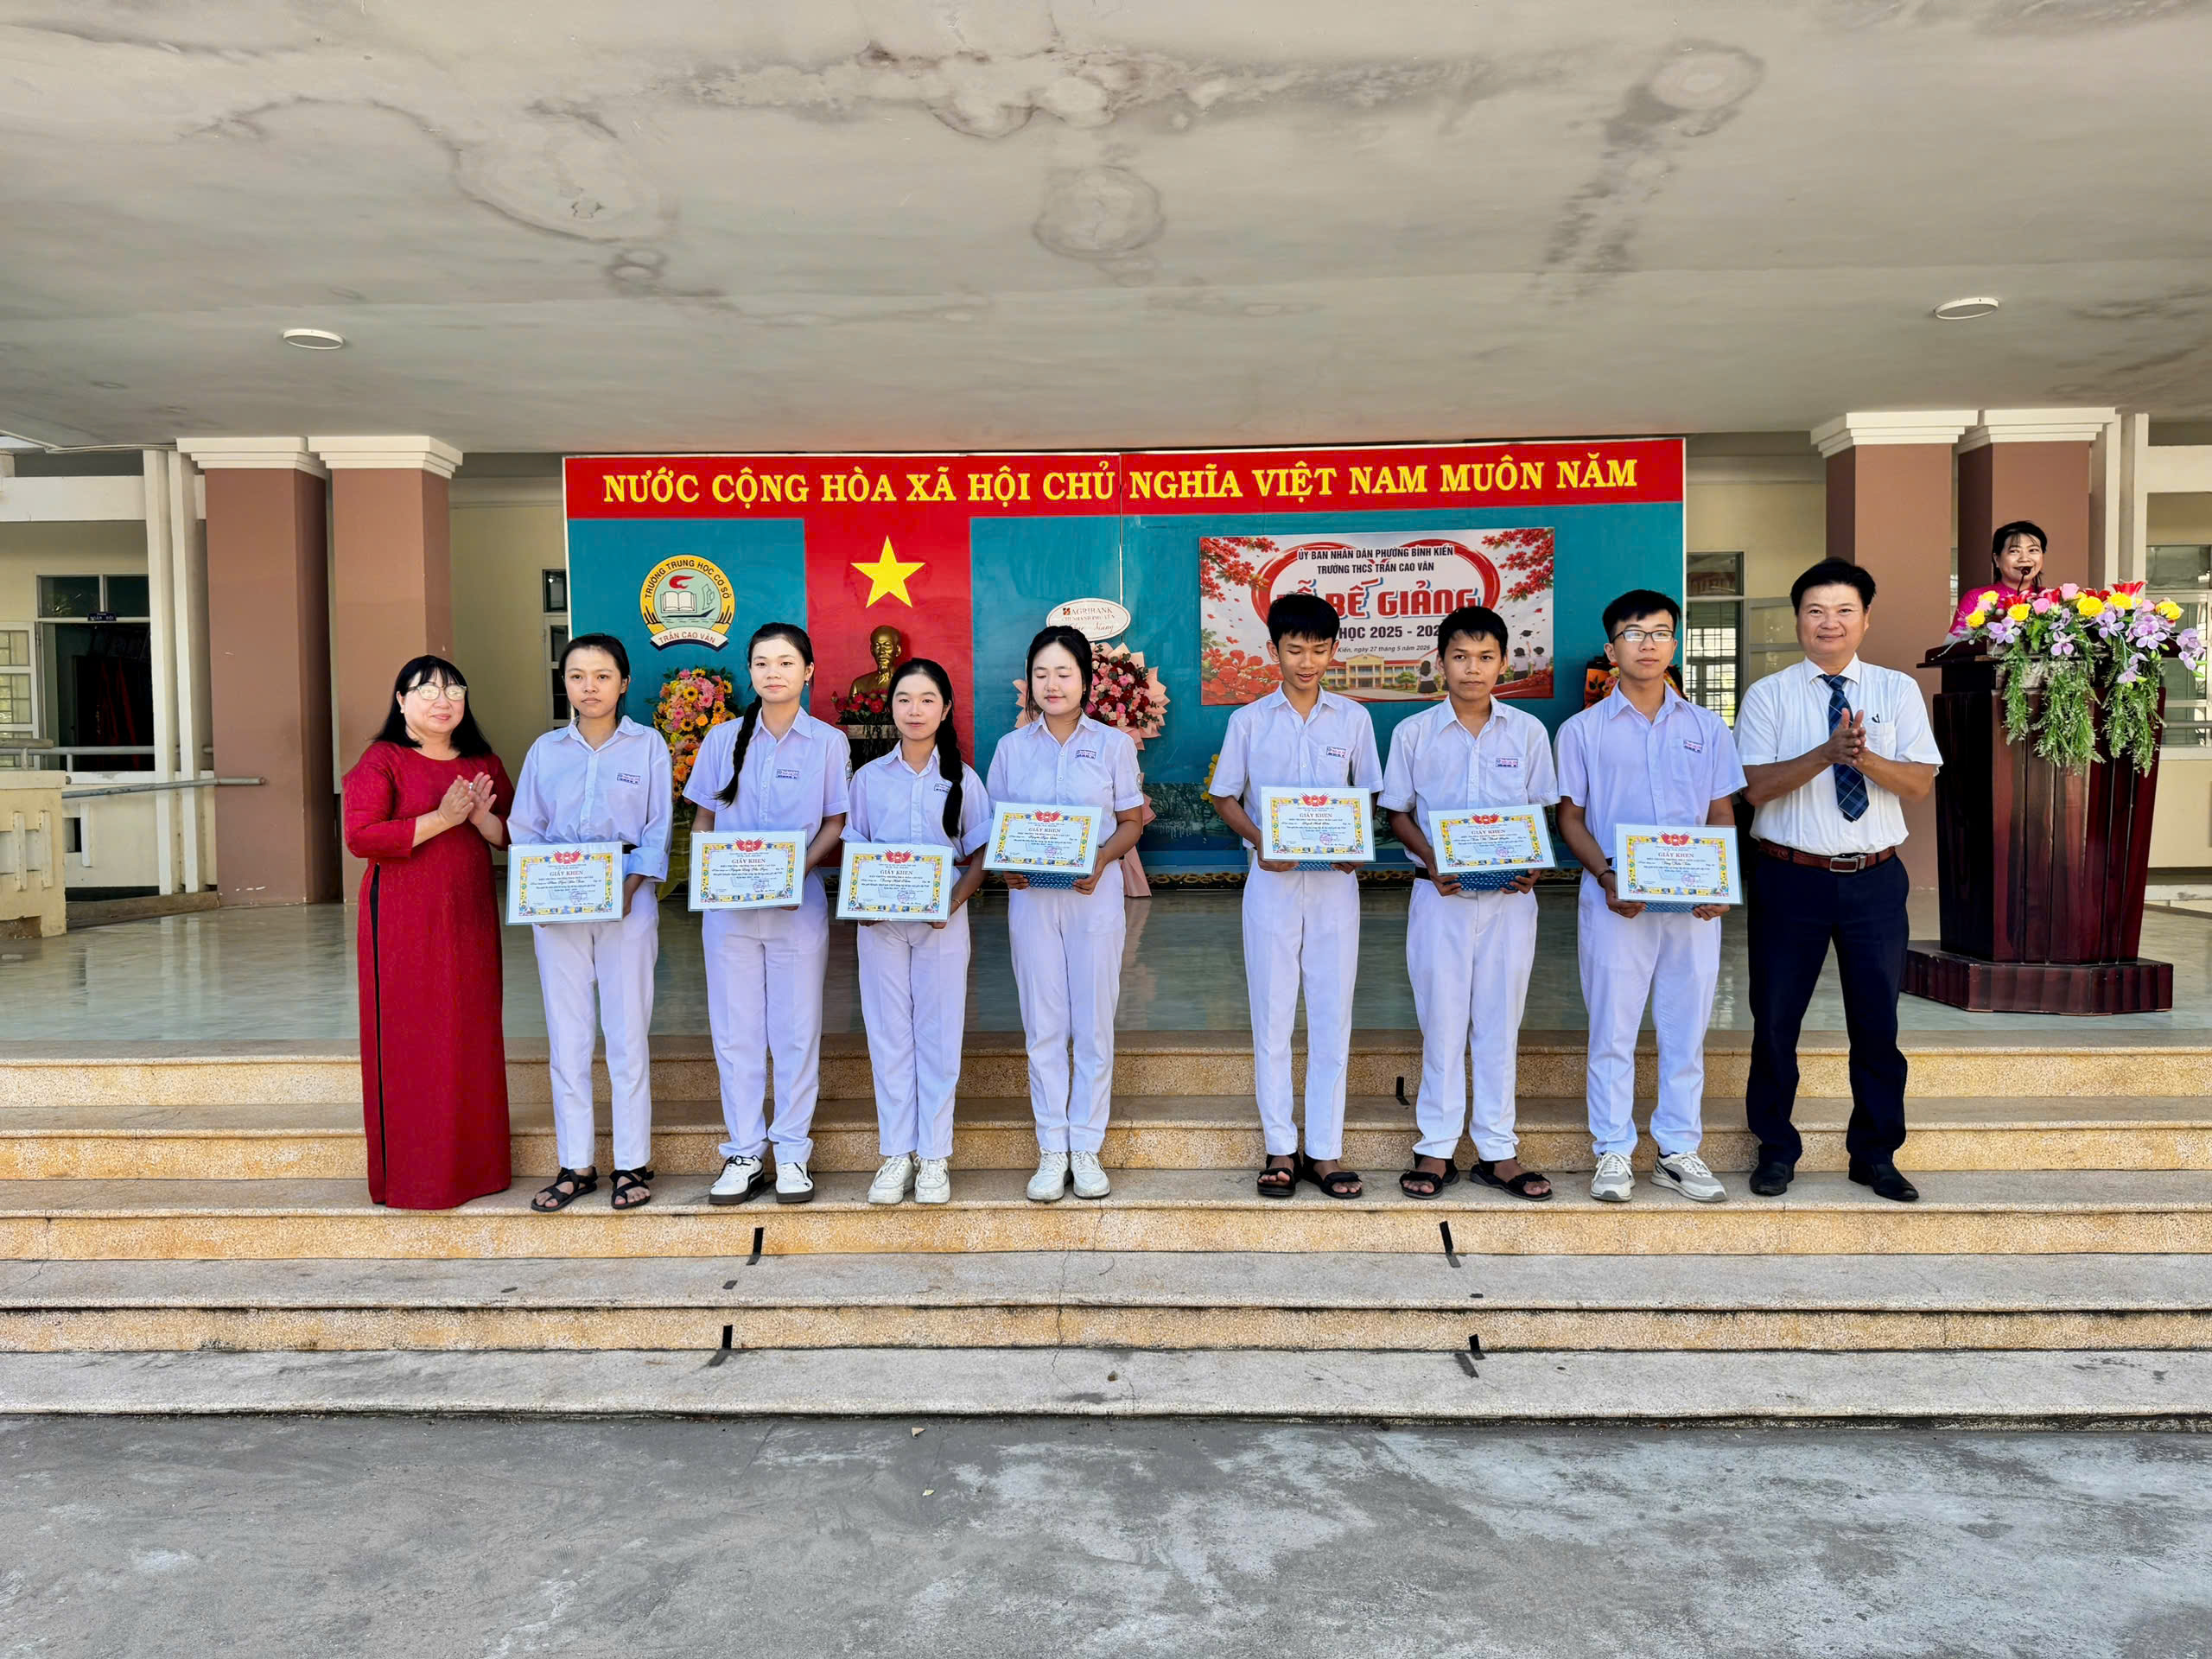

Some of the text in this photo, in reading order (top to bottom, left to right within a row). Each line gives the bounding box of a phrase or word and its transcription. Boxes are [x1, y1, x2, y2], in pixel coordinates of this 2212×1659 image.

[602, 451, 1637, 509] NƯỚC CỘNG HÒA XÃ HỘI CHỦ NGHĨA VIỆT NAM MUÔN NĂM
[1298, 543, 1453, 560] ỦY BAN NHÂN DÂN PHƯỜNG BÌNH KIẾN
[666, 559, 695, 570] TRUNG
[696, 562, 715, 575] HỌC
[713, 574, 725, 586] CƠ
[1317, 563, 1350, 575] TRƯỜNG
[1351, 564, 1373, 574] THCS
[1399, 563, 1415, 572] CAO
[1417, 561, 1434, 572] VÂN
[1377, 580, 1478, 617] GIẢNG
[1071, 607, 1113, 615] AGRIBANK
[1339, 626, 1365, 641] HỌC
[1370, 626, 1402, 639] 2025
[1416, 625, 1439, 637] 202
